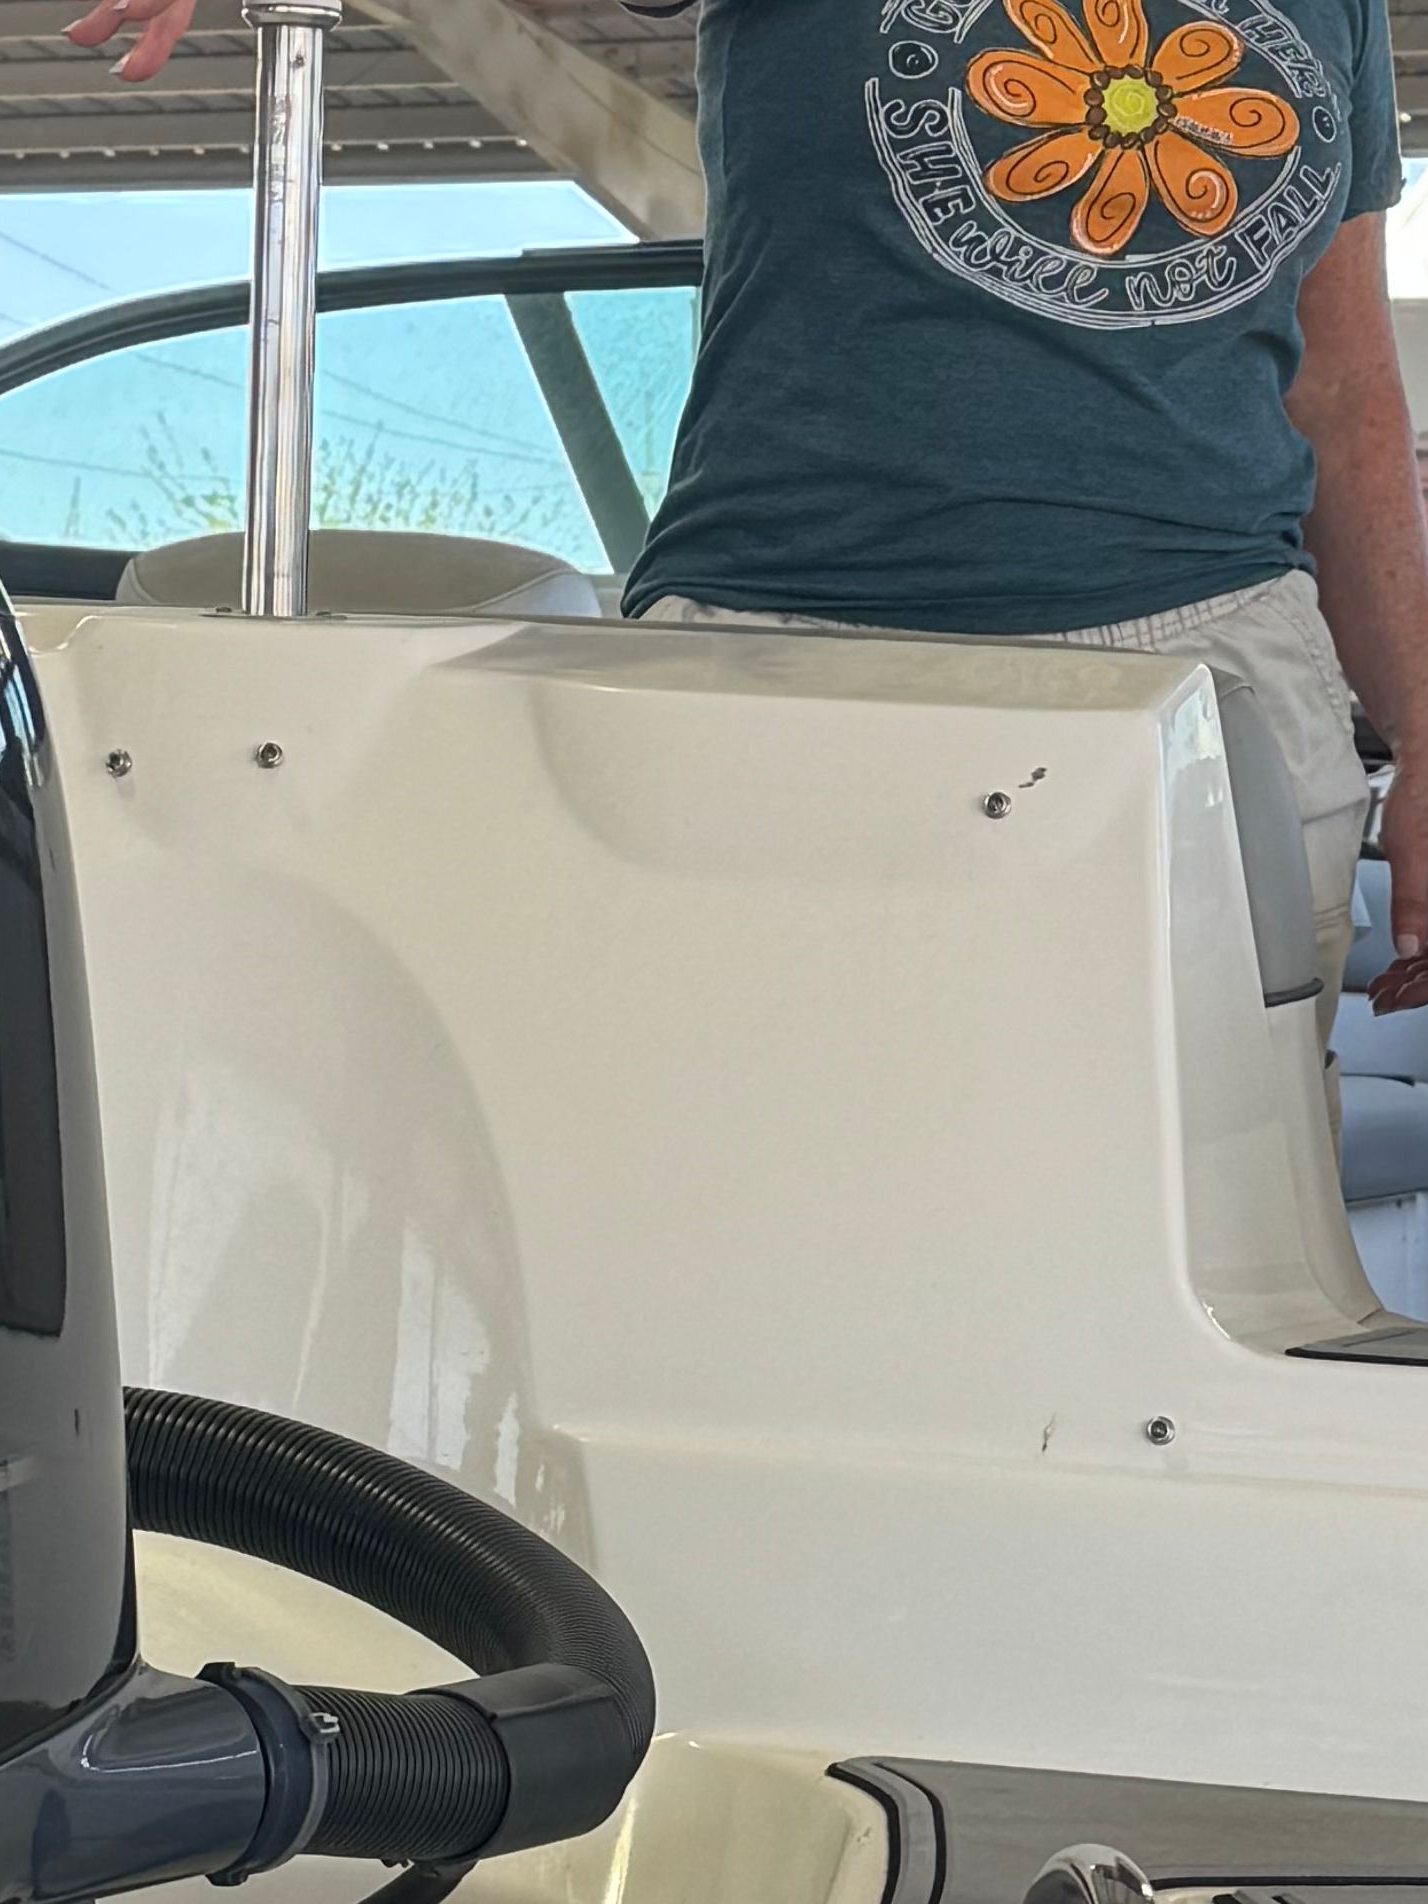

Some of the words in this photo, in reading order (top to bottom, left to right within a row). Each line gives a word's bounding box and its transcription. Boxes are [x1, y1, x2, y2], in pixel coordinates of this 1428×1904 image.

[884, 98, 974, 224] SHE
[951, 220, 1109, 307] will
[1126, 246, 1237, 311] not
[1237, 162, 1342, 269] FALL
